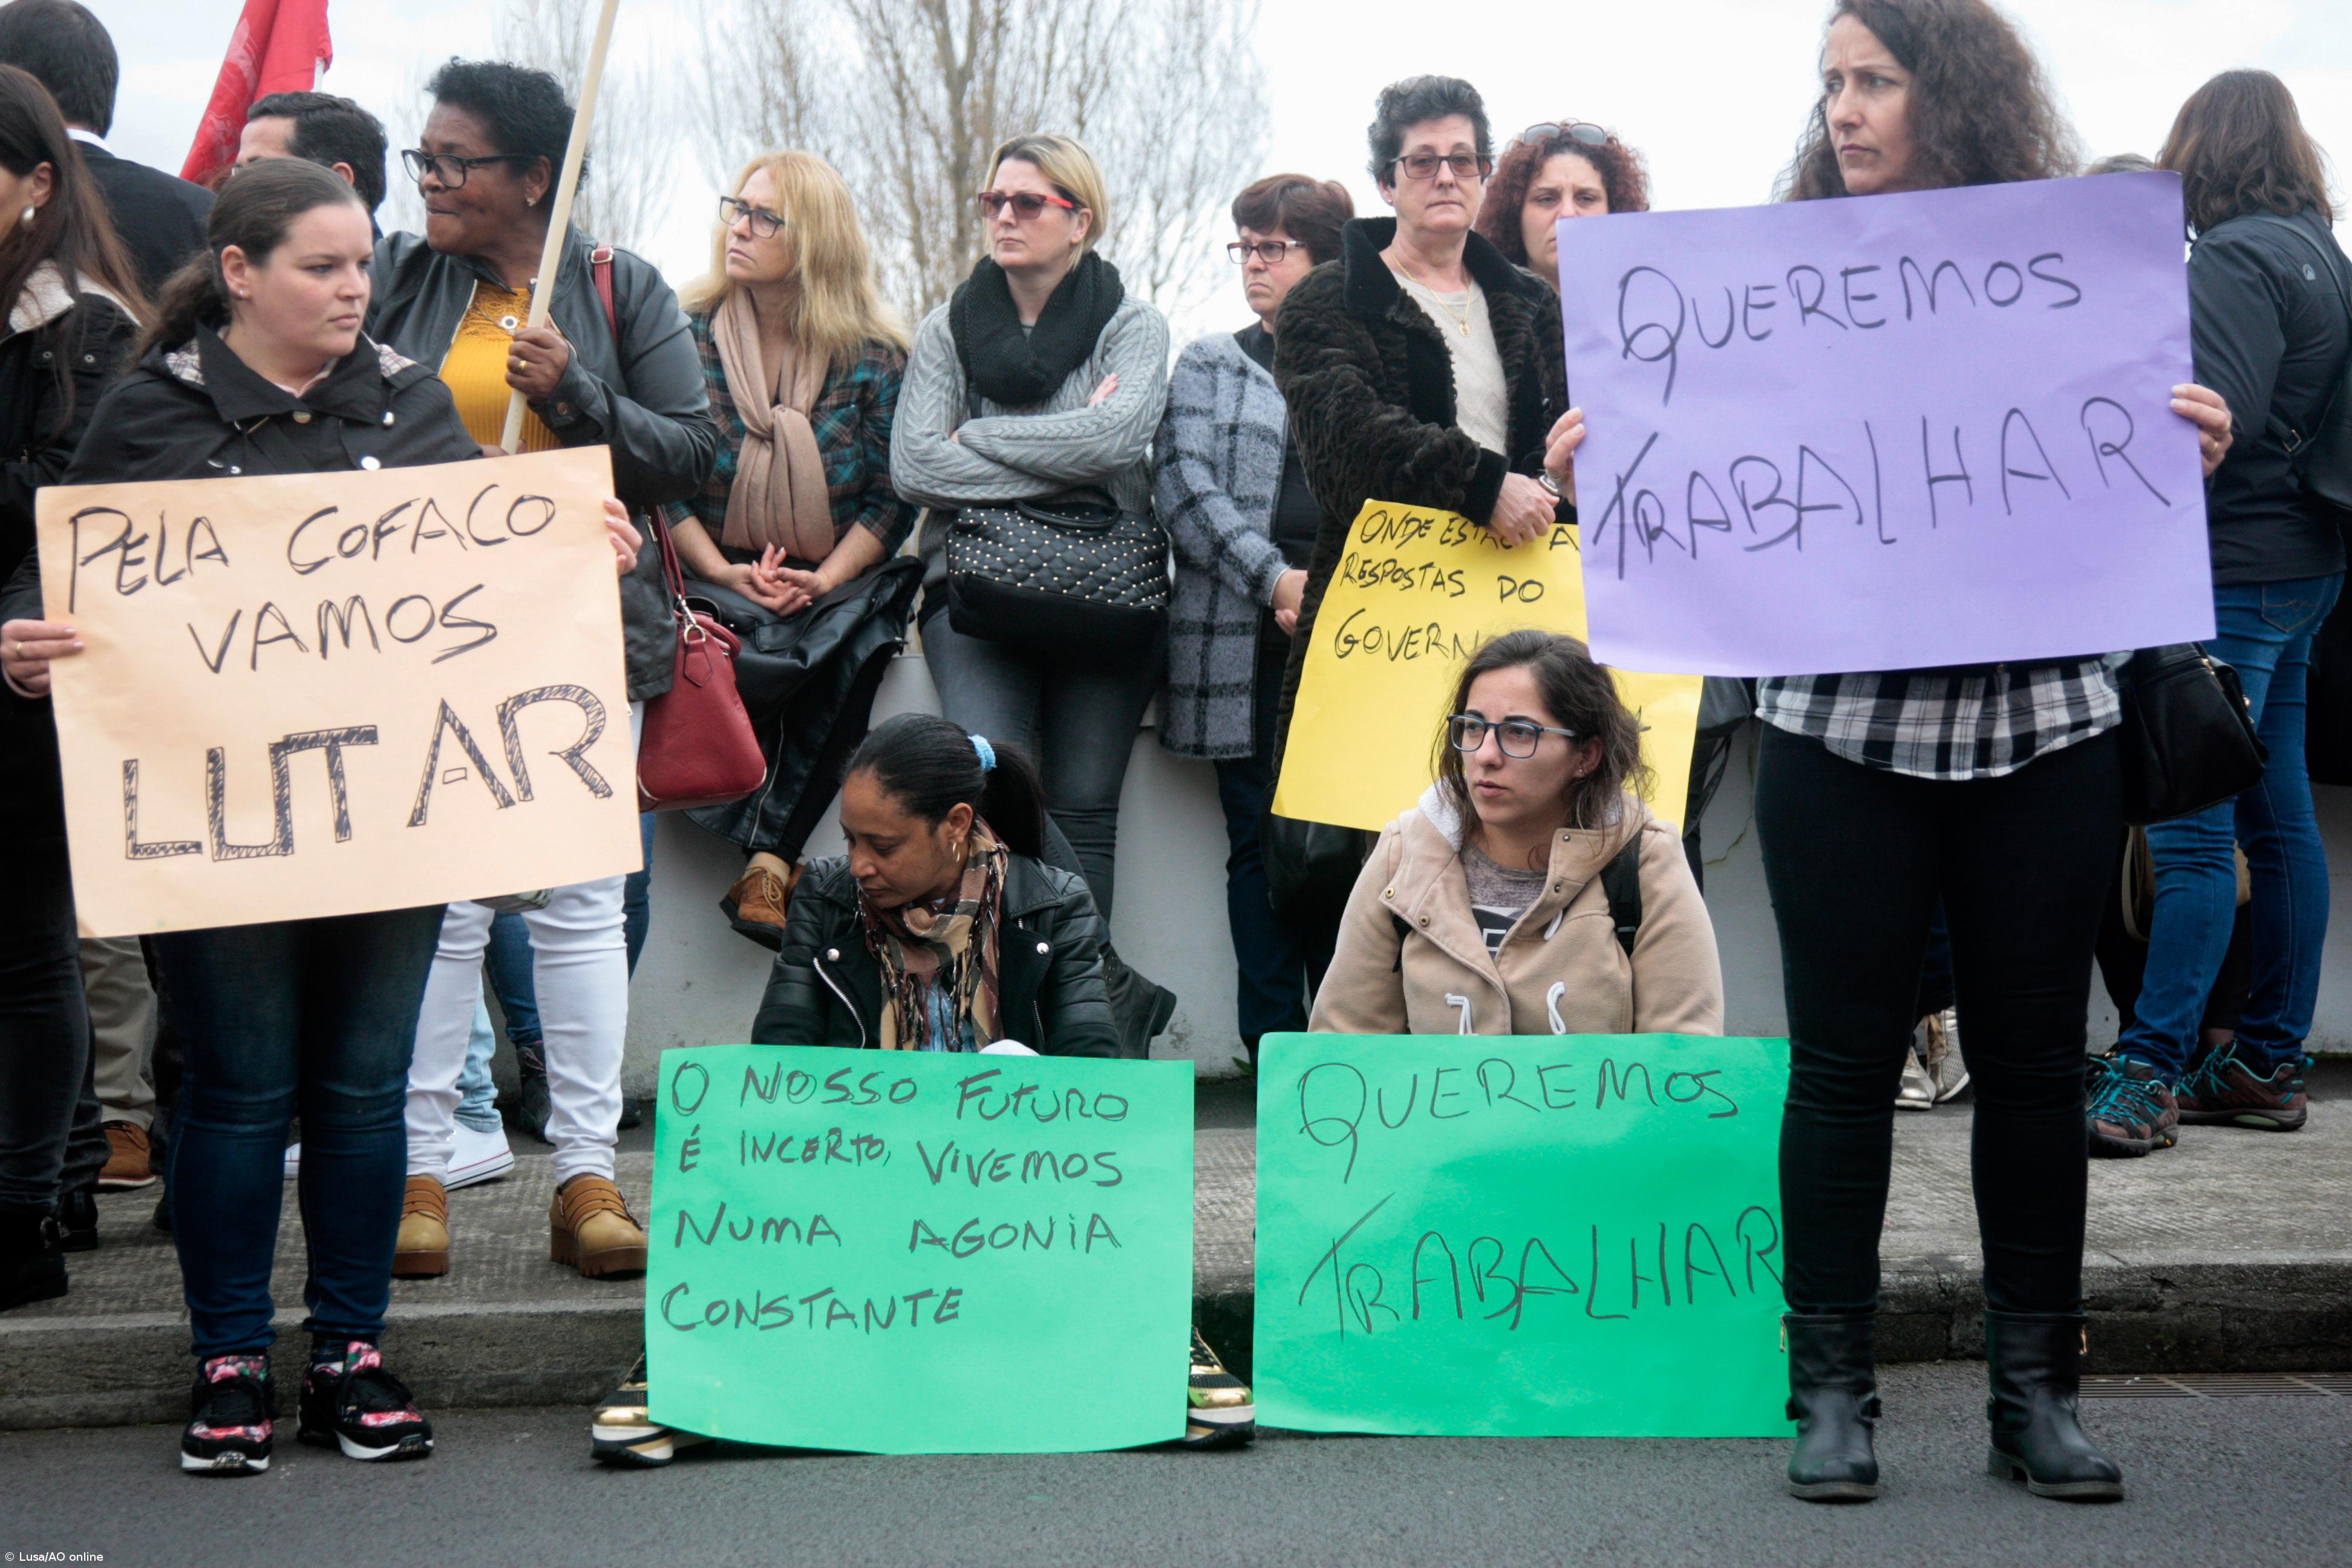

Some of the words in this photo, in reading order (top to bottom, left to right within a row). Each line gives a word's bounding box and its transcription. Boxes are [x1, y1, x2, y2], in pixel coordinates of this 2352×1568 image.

[1618, 252, 2082, 407] QUEREMOS
[1360, 509, 1434, 549] ONDE
[1549, 525, 1581, 551] A
[1592, 396, 2172, 580] TRABALHAR
[69, 506, 229, 613] PELA
[287, 484, 555, 575] COFACO
[1339, 552, 1465, 598] RESPOSTAS
[1497, 575, 1544, 603] DO
[188, 584, 498, 673] VAMOS
[1334, 608, 1480, 662] GOVERN
[122, 684, 613, 861] LUTAR
[671, 1060, 709, 1116] O
[740, 1061, 918, 1108] NOSSO
[1298, 1058, 1739, 1184] QUEREMOS
[678, 1125, 702, 1173] É
[740, 1128, 892, 1167] INCERTO,
[661, 1282, 963, 1335] CONSTANTE
[1299, 1192, 1784, 1343] TRABALHAR
